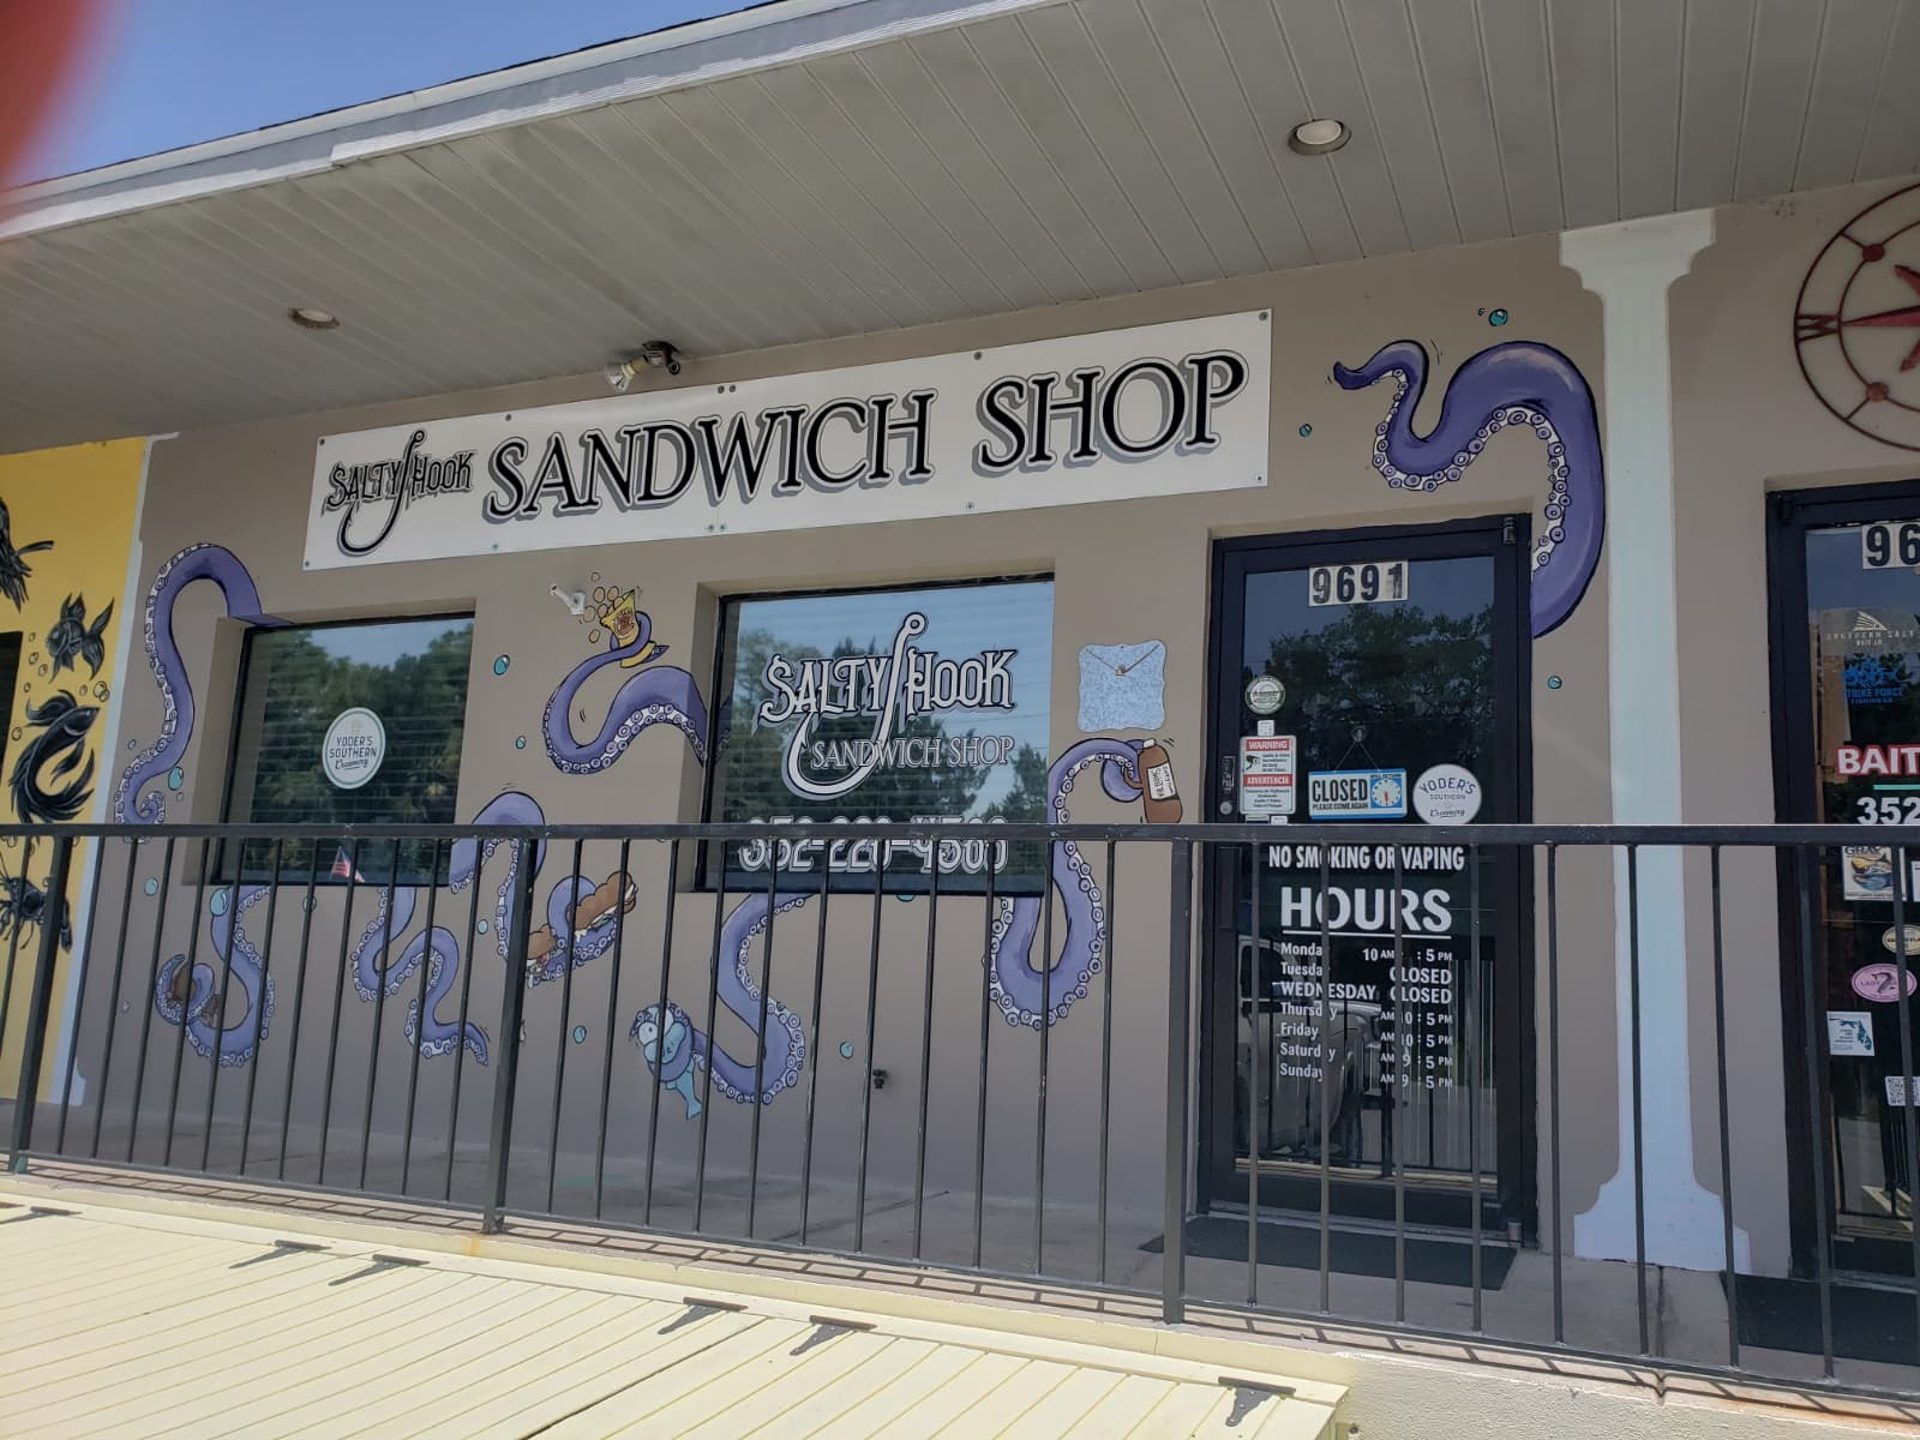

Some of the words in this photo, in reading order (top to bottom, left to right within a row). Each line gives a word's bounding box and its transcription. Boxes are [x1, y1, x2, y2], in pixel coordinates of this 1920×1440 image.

[323, 457, 402, 515] SALTY
[404, 450, 478, 506] HOOK
[482, 387, 938, 525] SANDWICH
[972, 349, 1250, 478] SHOP
[1312, 563, 1404, 604] 9691
[757, 653, 894, 724] SALTY
[903, 648, 1018, 717] HOOK
[328, 747, 377, 759] SOUTHERN
[810, 738, 942, 769] SANDWICH
[946, 736, 1015, 767] SHOP
[1248, 741, 1288, 750] WARNING
[1312, 779, 1368, 802] CLOSED
[1419, 777, 1477, 795] YODER'S
[1429, 793, 1466, 801] SOUTHERN
[1269, 846, 1291, 868] NO
[1401, 846, 1465, 870] VAPING
[1281, 887, 1452, 932] HOURS
[1281, 942, 1323, 956] Monda
[1363, 948, 1378, 961] 10
[1426, 949, 1435, 962] 5
[1438, 952, 1452, 961] PM
[1281, 962, 1323, 976] Tuesda
[1389, 966, 1452, 985] CLOSED
[1281, 981, 1376, 1000] WEDNESDAY
[1390, 986, 1452, 1004] CLOSED
[1281, 1002, 1337, 1021] Thursdy
[1380, 1011, 1395, 1020] AM
[1426, 1012, 1435, 1026] 5
[1438, 1014, 1453, 1024] PM
[1281, 1022, 1319, 1041] Friday
[1380, 1032, 1395, 1041] AM
[1426, 1034, 1435, 1047] 5
[1438, 1035, 1453, 1045] PM
[1280, 1042, 1336, 1062] Saturdy
[1380, 1053, 1395, 1062] AM
[1426, 1056, 1435, 1069] 5
[1438, 1056, 1453, 1066] PM
[1380, 1074, 1395, 1083] AM
[1426, 1075, 1435, 1089] 5
[1438, 1078, 1453, 1087] PM
